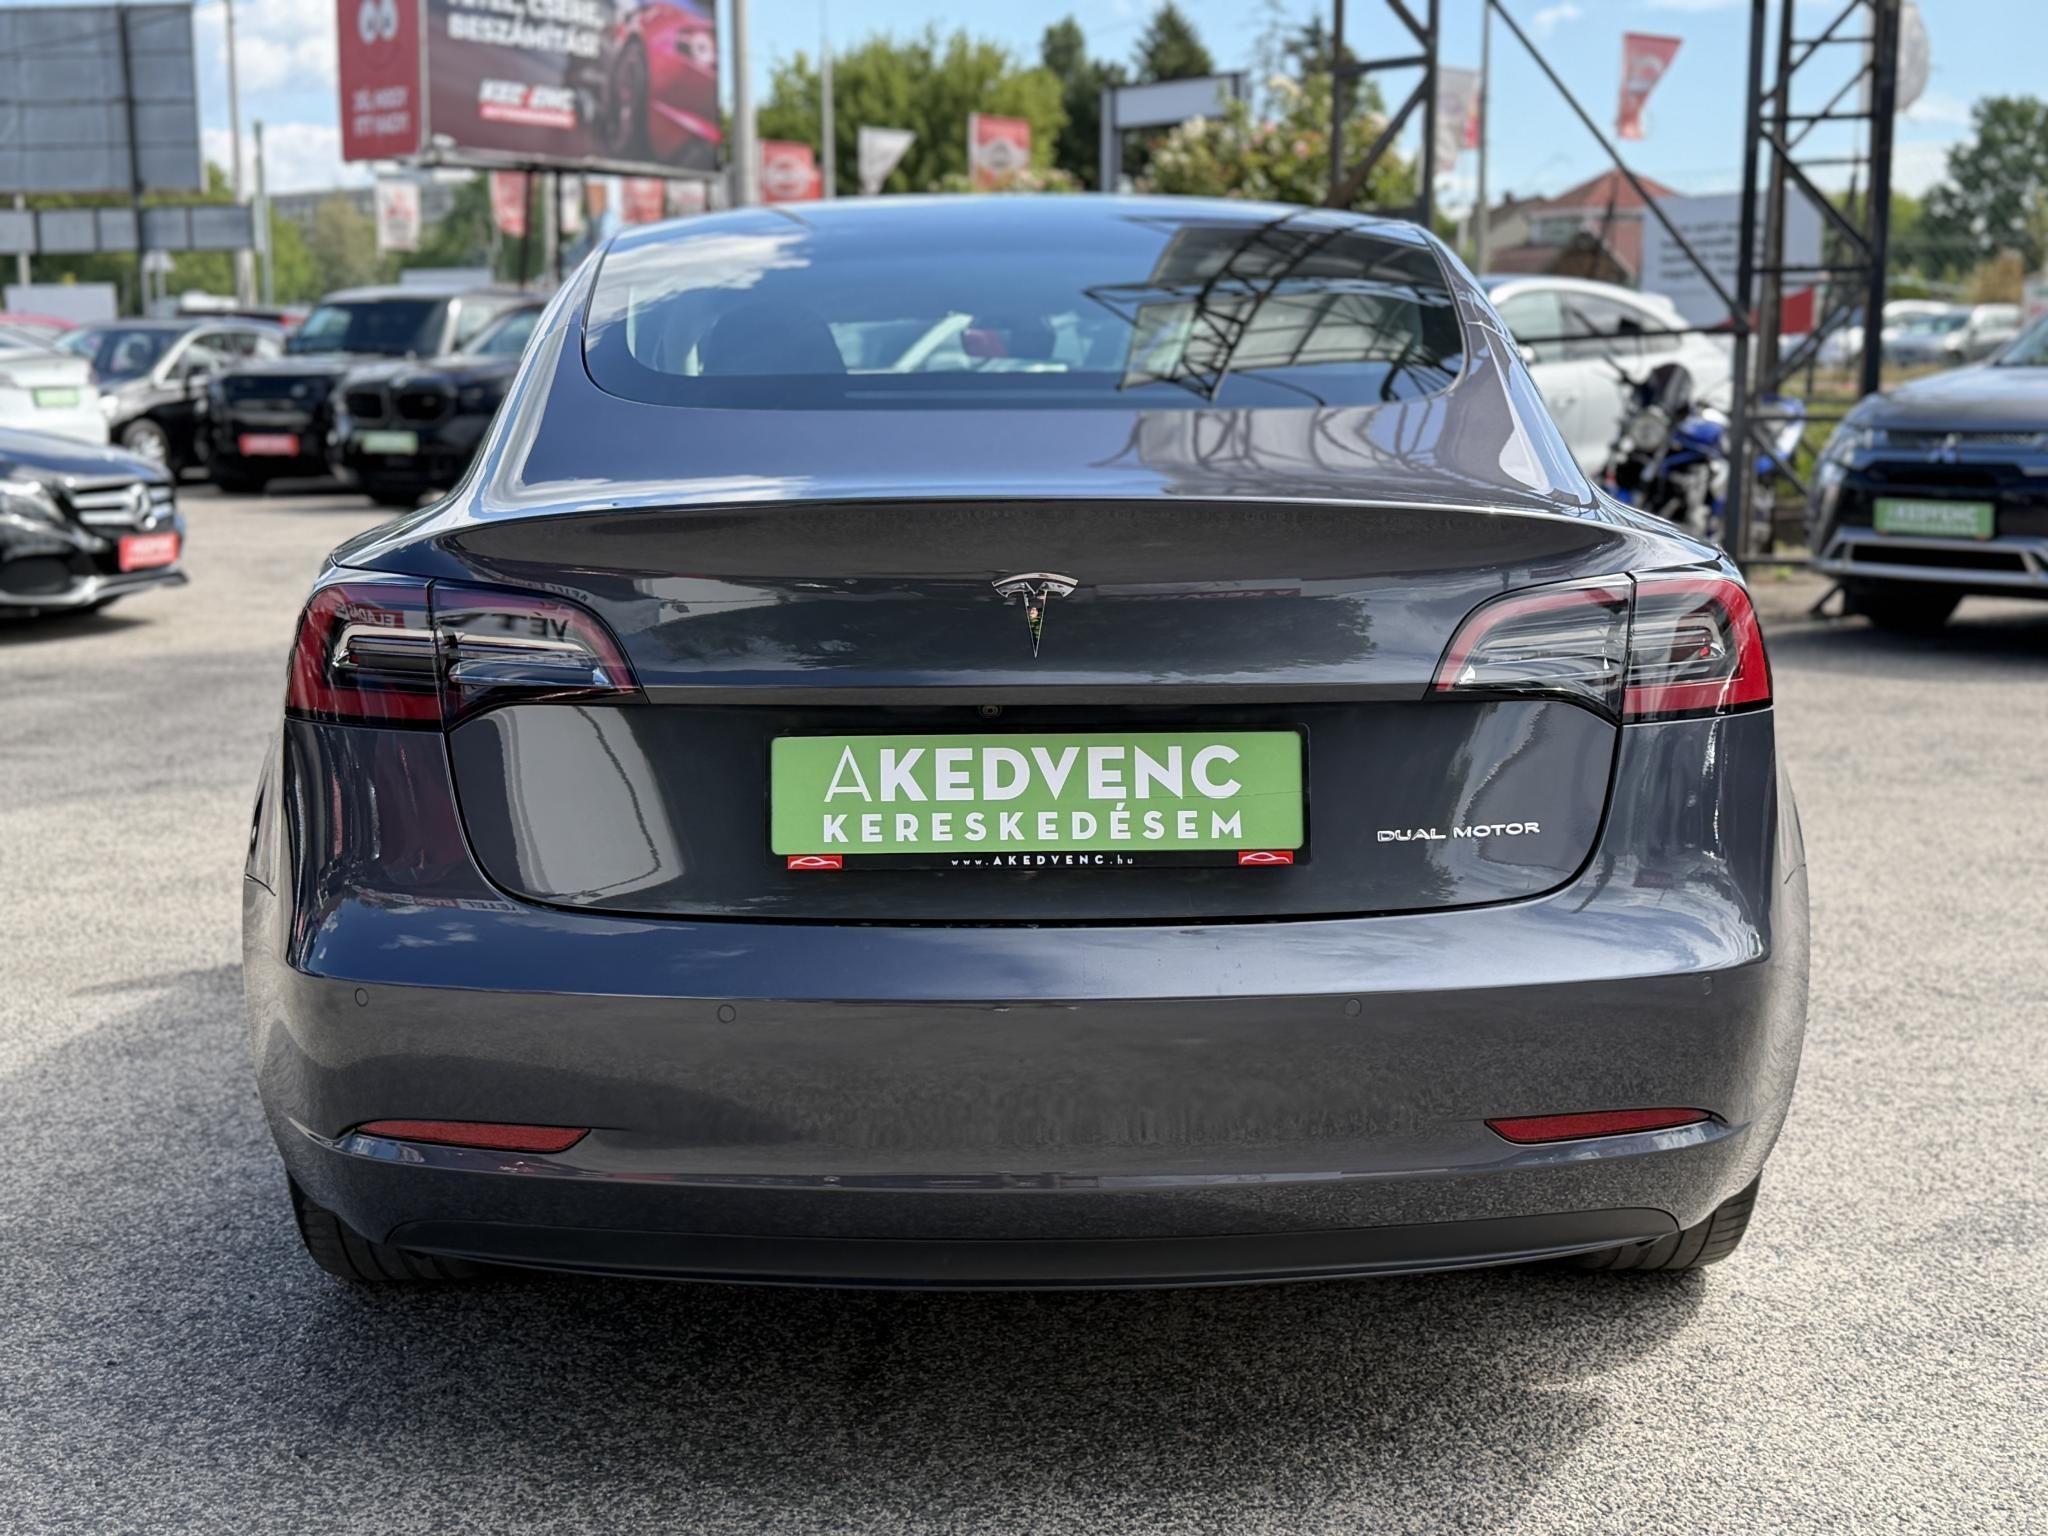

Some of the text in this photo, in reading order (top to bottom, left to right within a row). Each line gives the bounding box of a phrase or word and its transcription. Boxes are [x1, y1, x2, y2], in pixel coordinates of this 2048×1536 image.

[823, 744, 1242, 802] AKEDVENC
[823, 803, 1243, 843] KERESKEDÉSEM
[1453, 822, 1541, 838] MOTOR
[1377, 828, 1447, 842] DUAL
[951, 855, 1134, 867] www.AKEDVENC.hu
